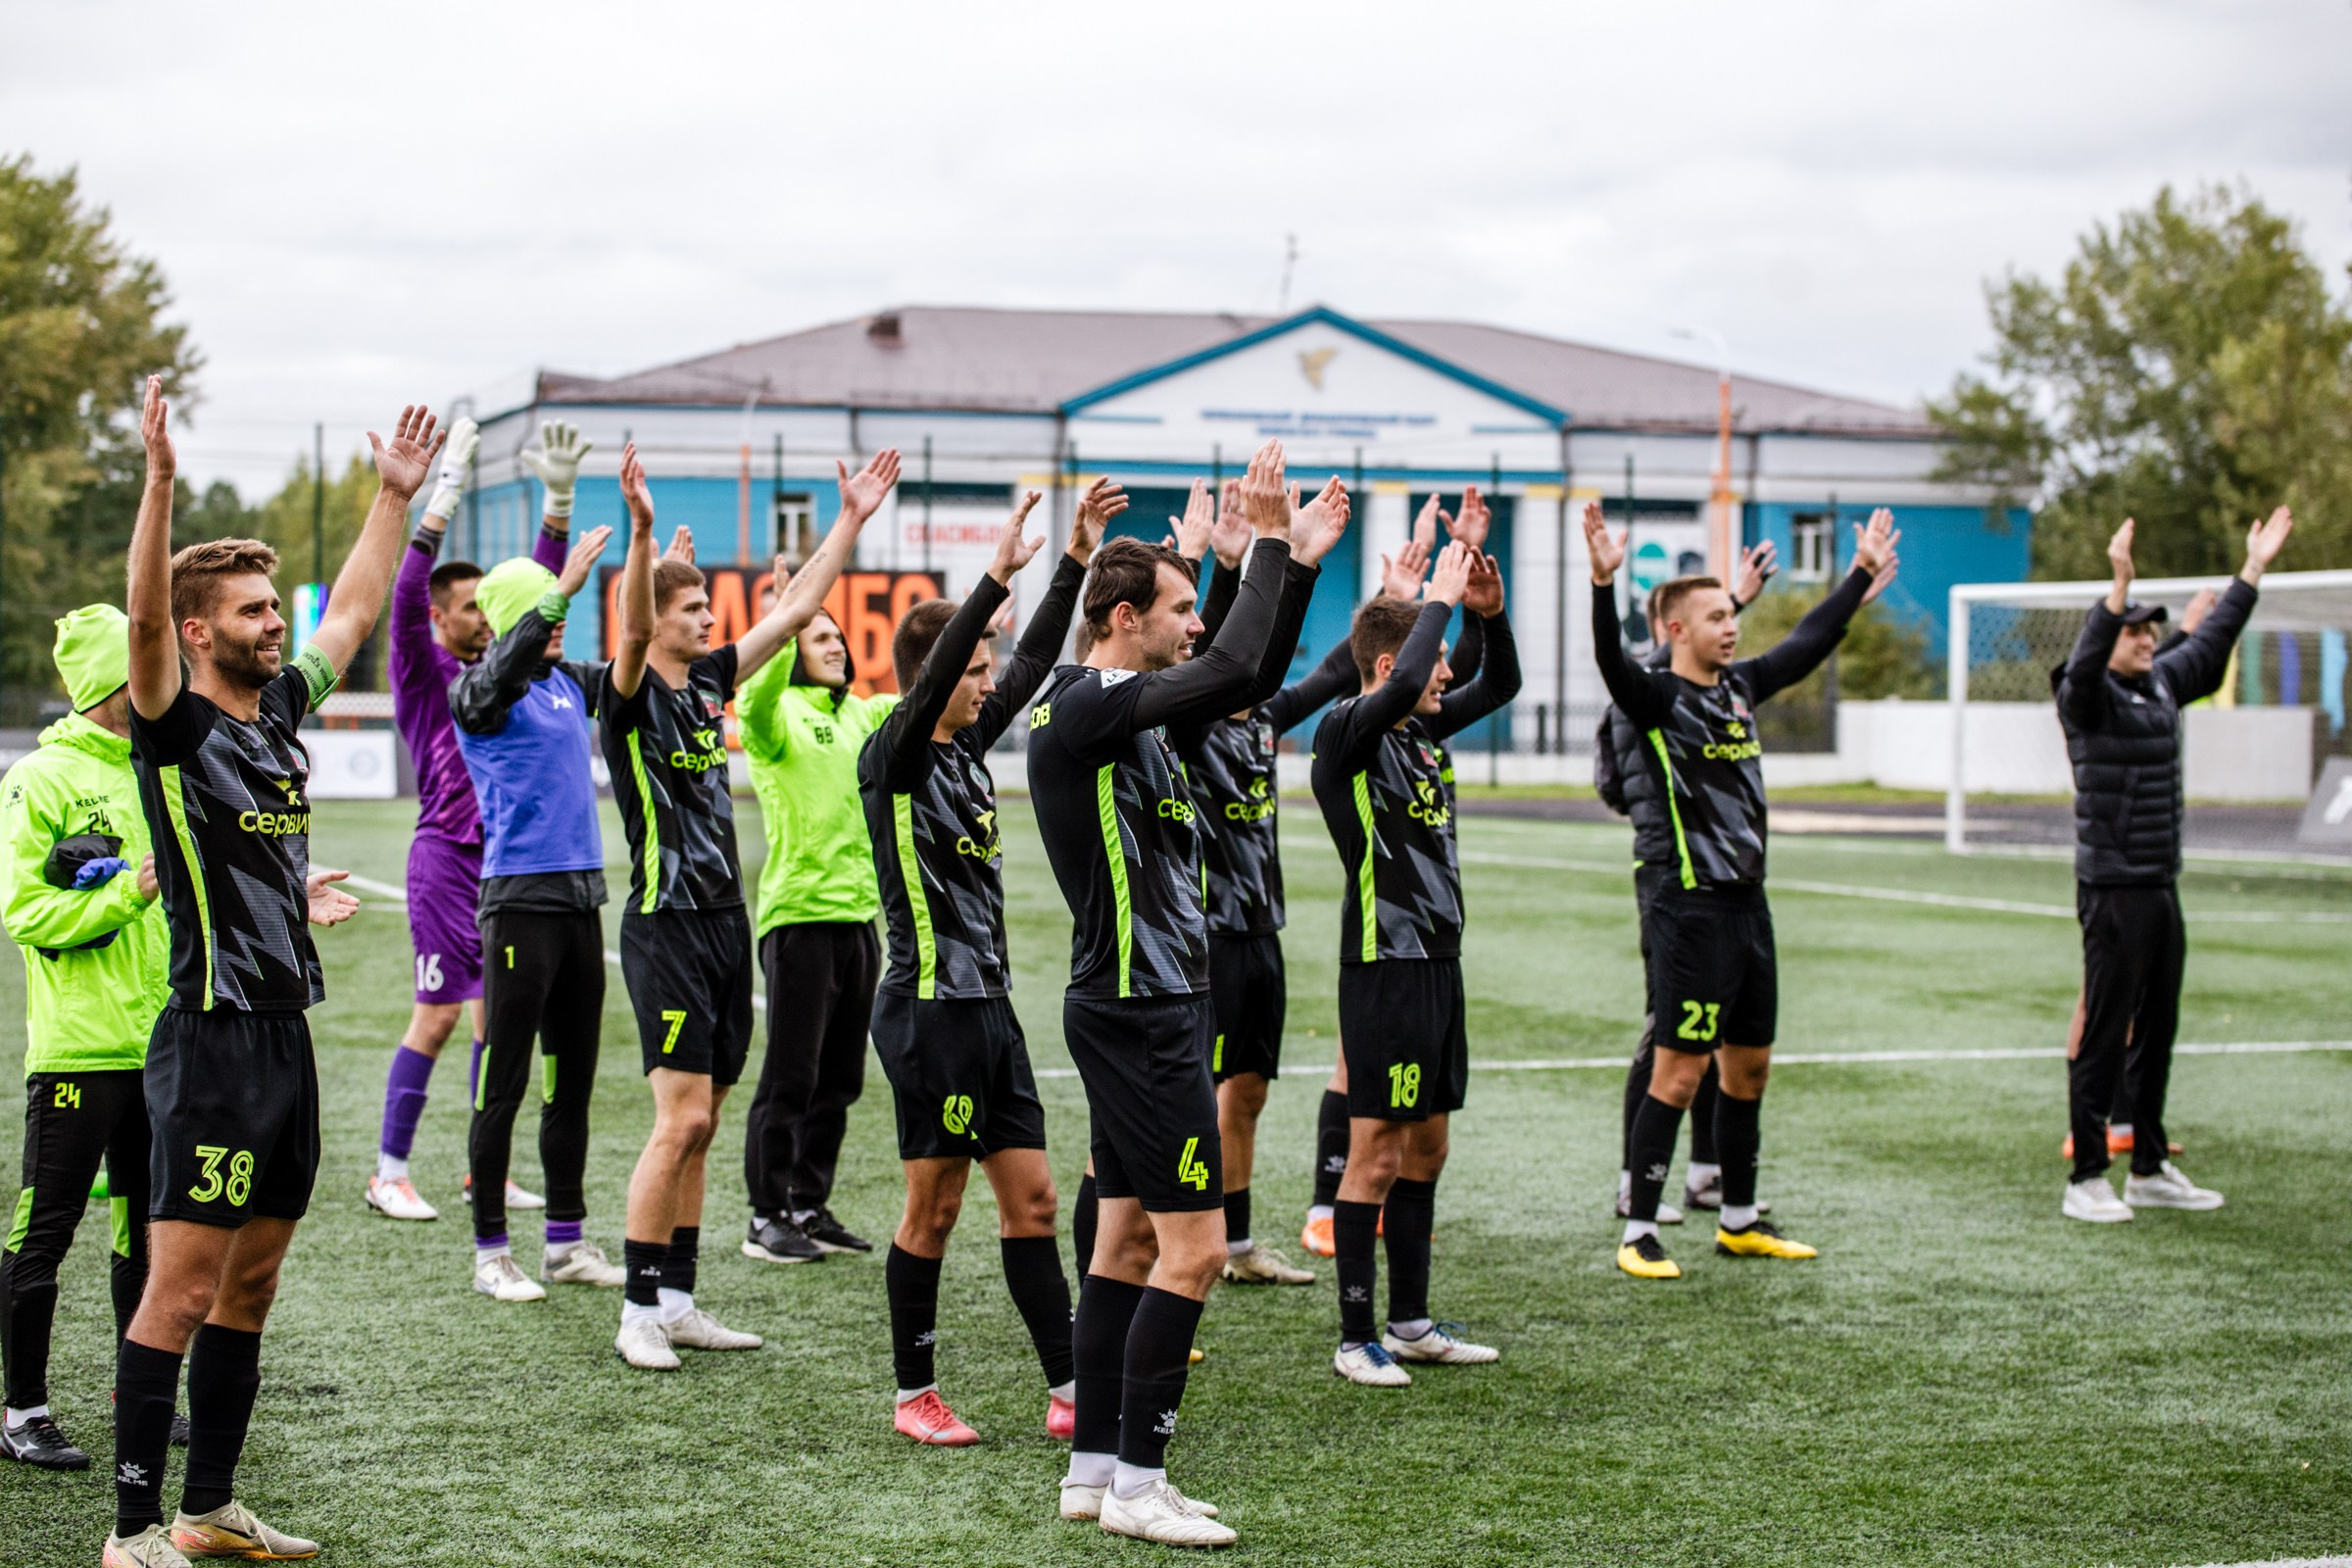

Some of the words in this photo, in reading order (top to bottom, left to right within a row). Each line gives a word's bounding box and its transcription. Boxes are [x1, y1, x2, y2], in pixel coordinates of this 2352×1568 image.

[814, 726, 834, 745] 69
[88, 808, 113, 834] 24
[238, 810, 311, 838] серви
[416, 954, 444, 992] 16
[505, 946, 514, 969] 1
[661, 1009, 688, 1054] 7
[1677, 1000, 1721, 1042] 23
[54, 1082, 80, 1109] 24
[1388, 1062, 1421, 1108] 18
[188, 1145, 255, 1206] 38
[1177, 1136, 1209, 1191] 4
